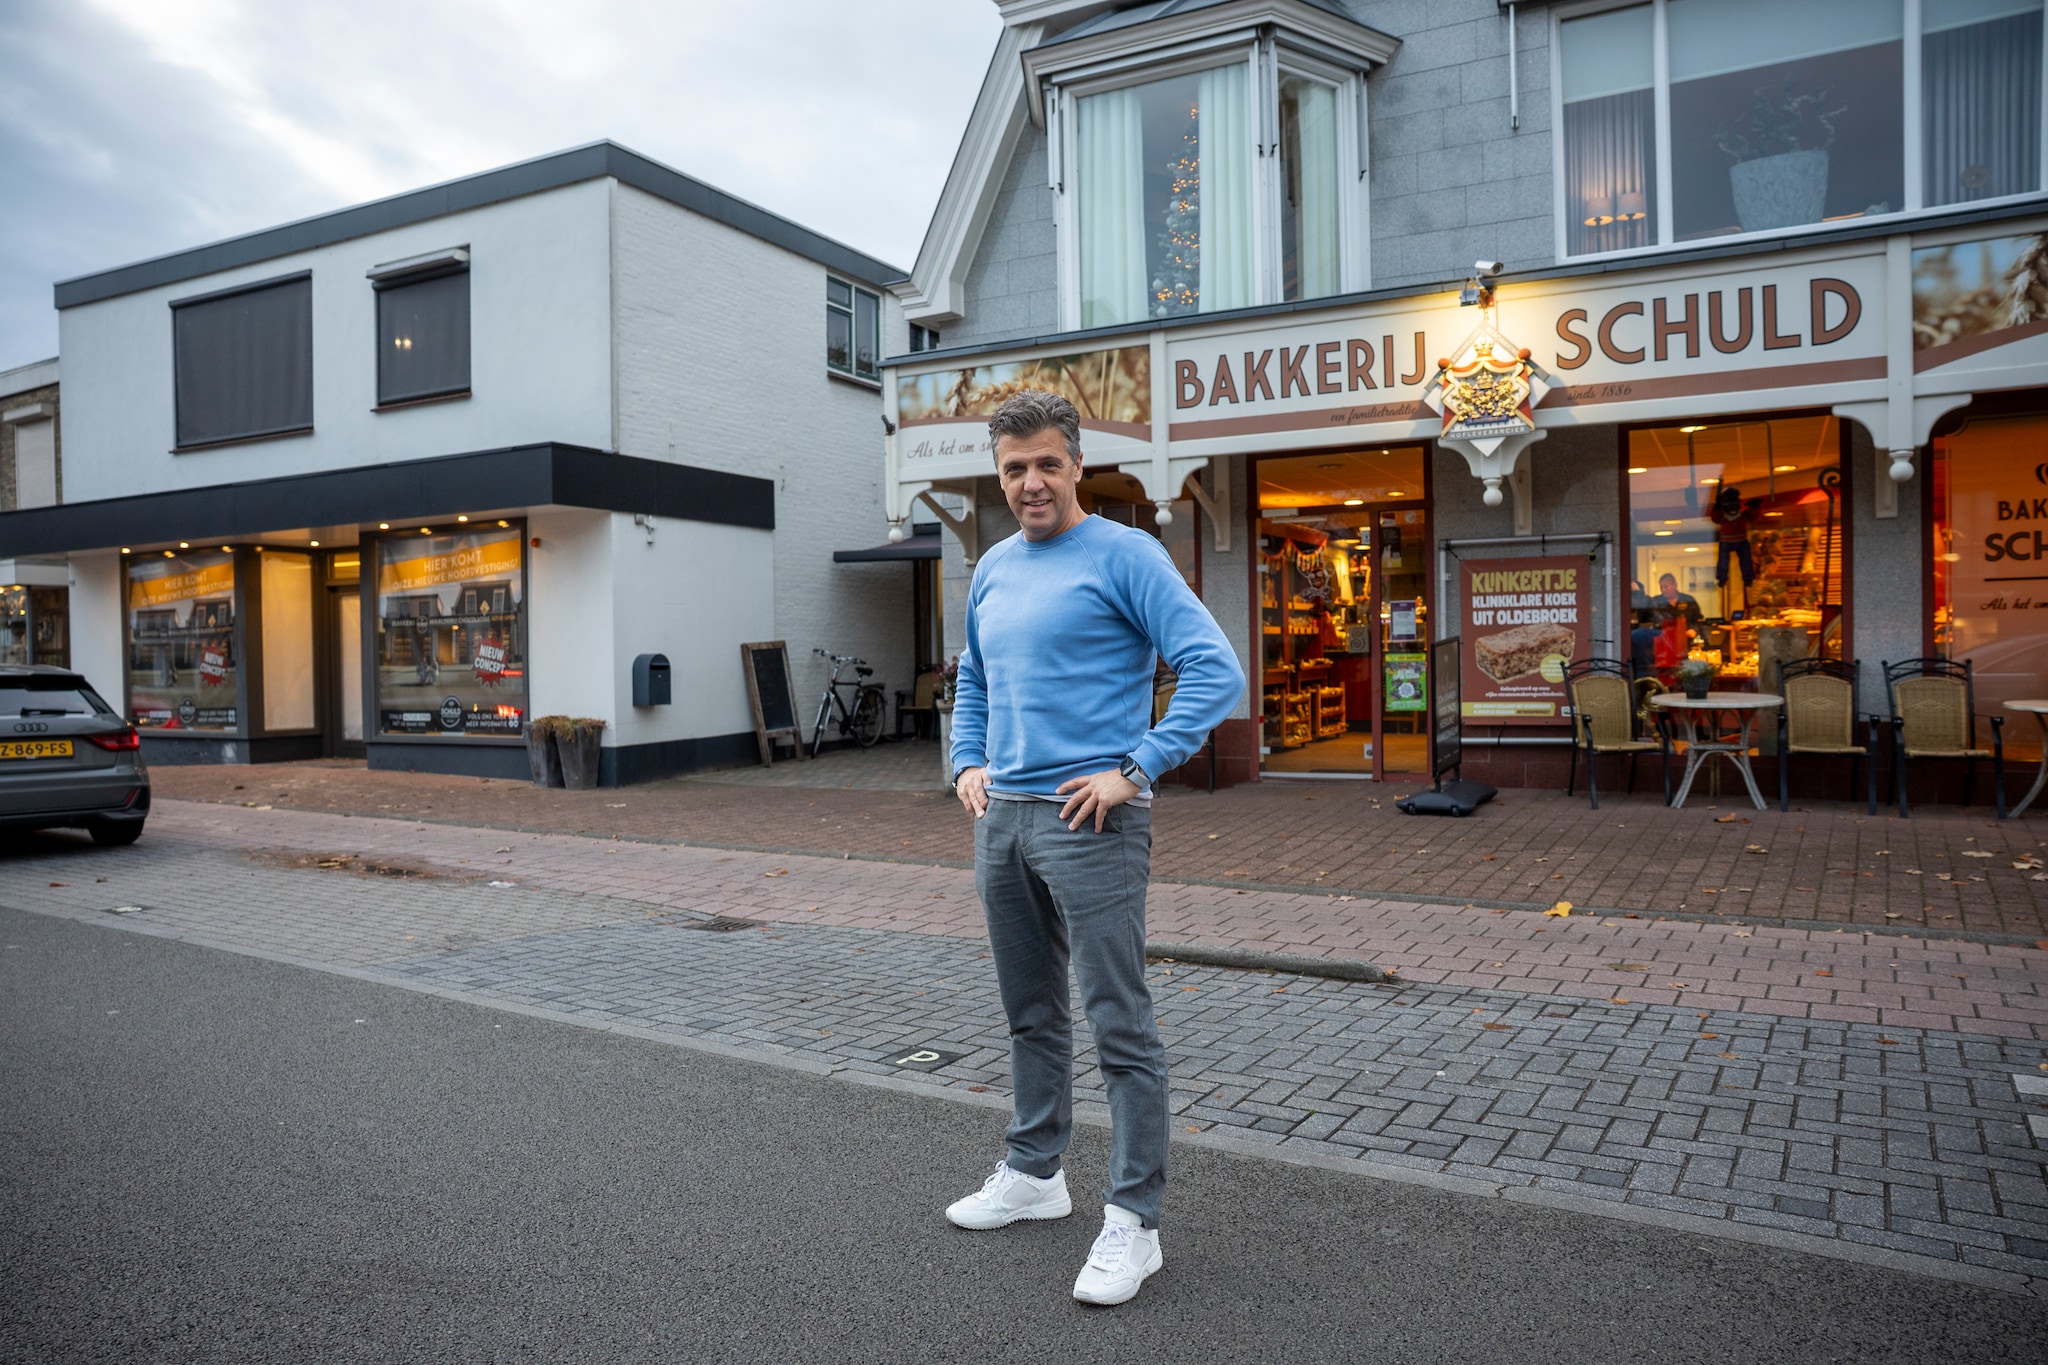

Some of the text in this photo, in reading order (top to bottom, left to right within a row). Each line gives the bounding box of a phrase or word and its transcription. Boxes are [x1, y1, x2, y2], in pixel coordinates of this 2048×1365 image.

[1175, 277, 1862, 409] BAKKERIJ SCHULD
[1330, 383, 1632, 425] een familietraditie sinds 1886
[1450, 426, 1526, 439] HOFLEVERANCIER
[907, 441, 933, 458] Als
[938, 438, 957, 455] het
[958, 443, 975, 453] om
[1998, 498, 2048, 521] BAK
[424, 550, 482, 573] HIER KOMT
[185, 571, 208, 587] KOMT
[414, 572, 446, 587] NIEUWE
[447, 557, 518, 580] HOOFDVESTIGING!
[1472, 592, 1577, 608] KLINKKLARE KOEK
[1980, 597, 2007, 611] Als
[2012, 597, 2032, 609] het
[1472, 608, 1578, 625] UIT OLDEBROEK
[479, 644, 505, 662] NIEUW
[474, 657, 506, 674] CONCEPT
[0, 742, 67, 757] Z-869-FS
